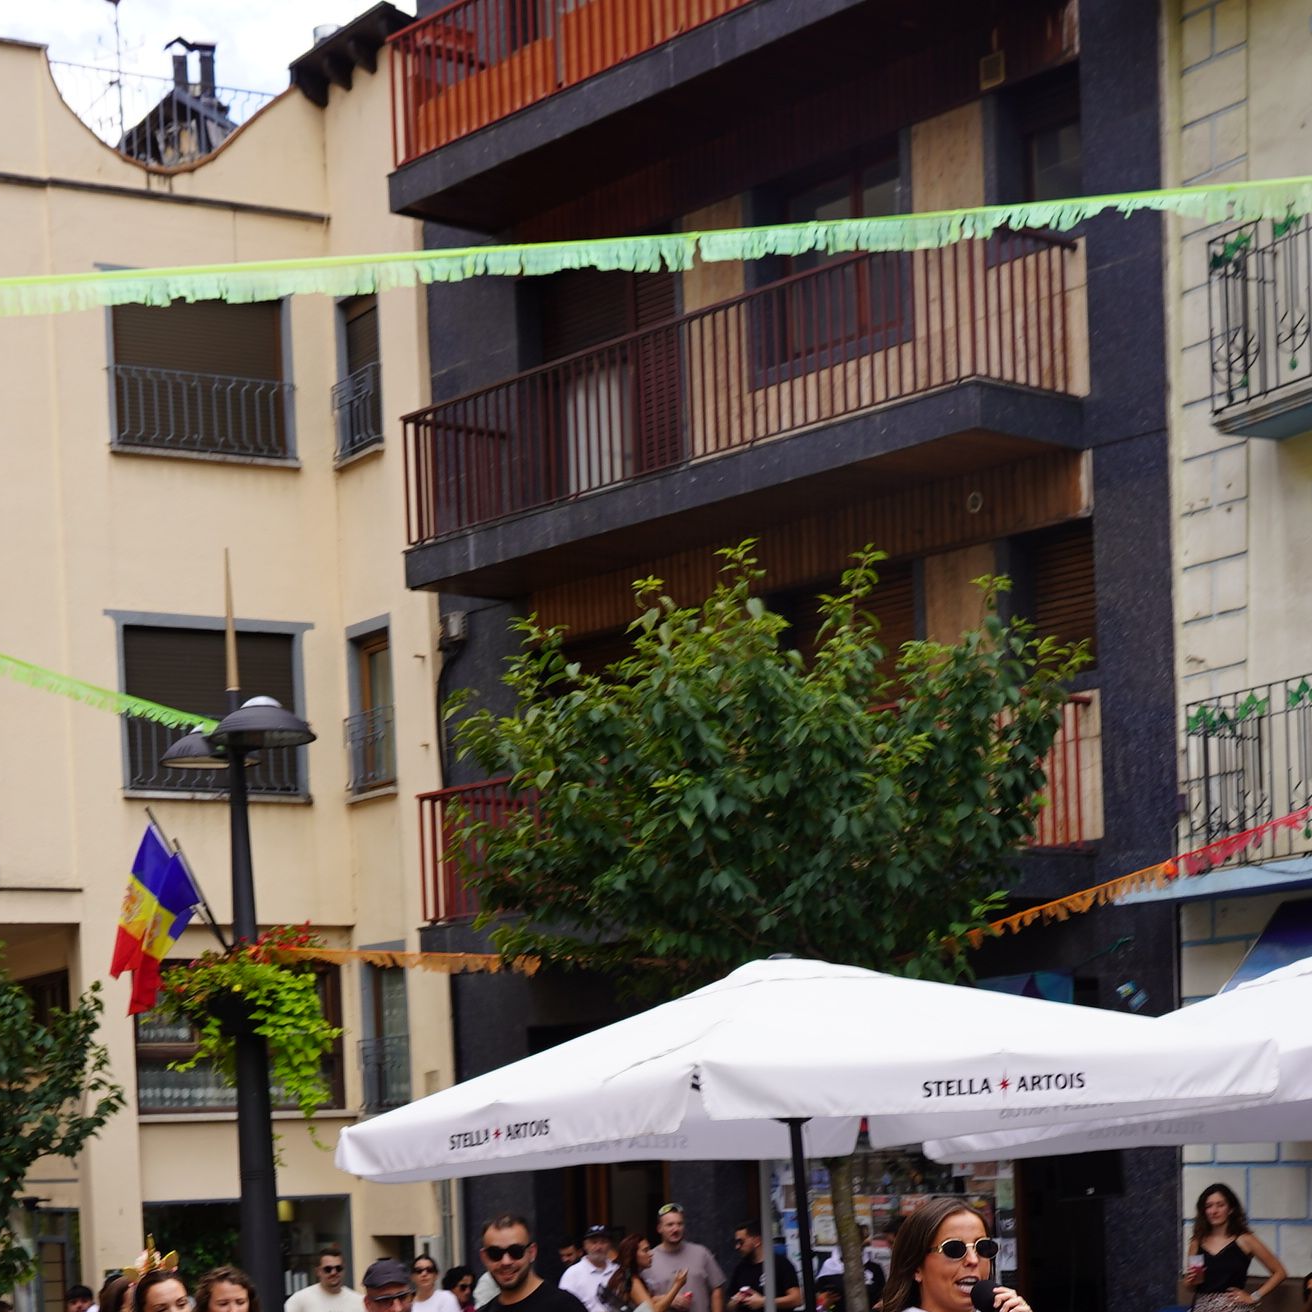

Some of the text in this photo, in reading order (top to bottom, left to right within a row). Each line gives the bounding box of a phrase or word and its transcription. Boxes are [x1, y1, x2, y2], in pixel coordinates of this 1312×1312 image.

[923, 1072, 1086, 1098] STELLA ARTOIS
[449, 1119, 550, 1150] STELLA ARTOIS
